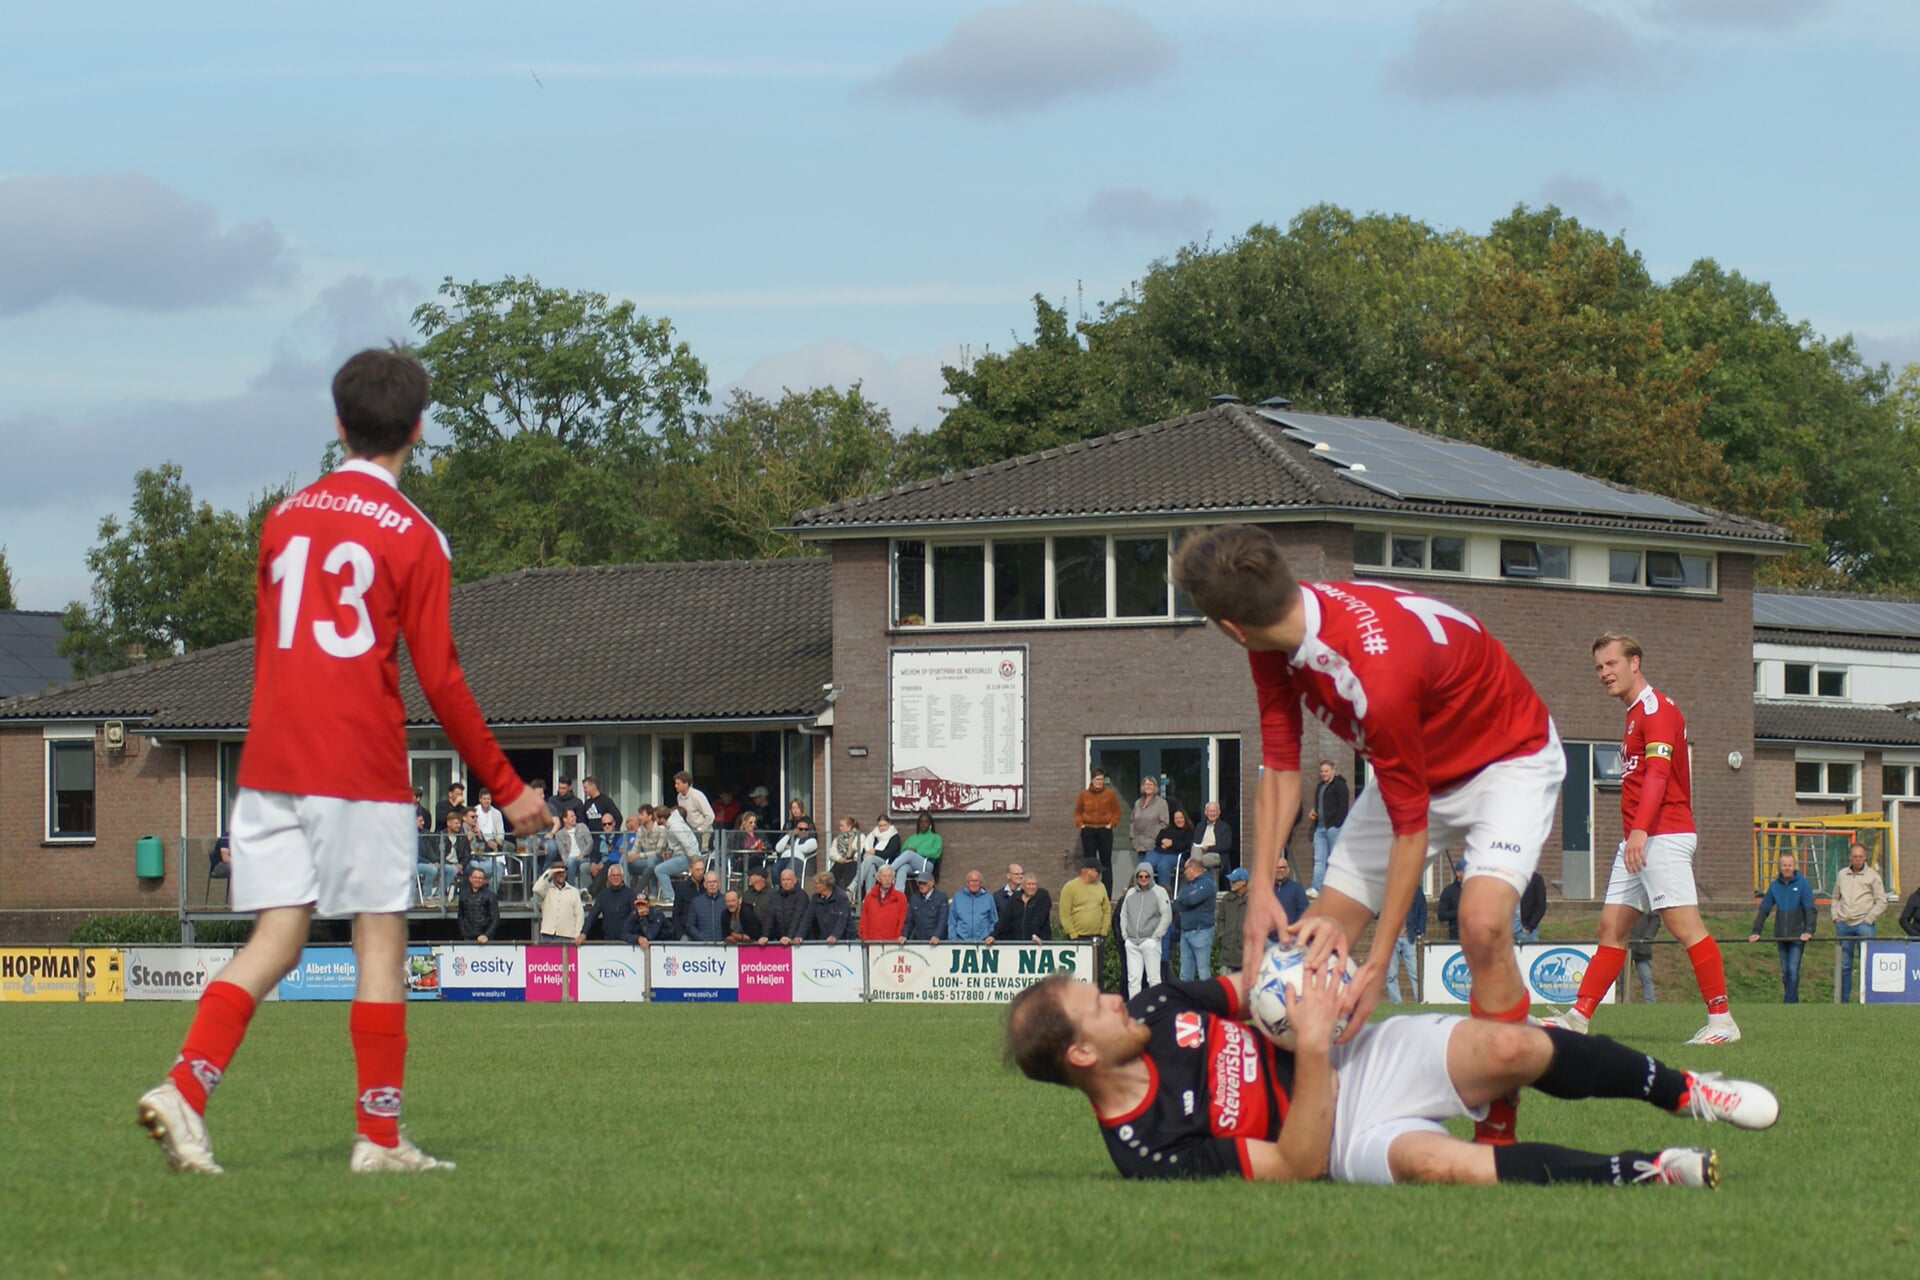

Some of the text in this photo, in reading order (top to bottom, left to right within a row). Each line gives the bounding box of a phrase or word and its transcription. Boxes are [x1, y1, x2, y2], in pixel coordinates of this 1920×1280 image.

[270, 535, 376, 659] 13
[1657, 744, 1669, 756] C
[1489, 841, 1521, 853] JAKO
[470, 956, 514, 977] essity
[682, 956, 726, 977] essity
[949, 949, 1077, 974] JAN NAS
[1879, 958, 1902, 971] bol
[306, 962, 355, 976] Albert Heijn
[528, 962, 576, 974] producert
[597, 968, 625, 978] TENA
[741, 962, 790, 974] produceert
[812, 968, 842, 979] TENA
[891, 965, 912, 974] JAN
[132, 965, 205, 986] Stamer
[533, 974, 543, 984] in
[746, 974, 785, 986] in Heijen
[932, 976, 964, 988] LOON-
[966, 976, 981, 988] EN
[872, 989, 914, 1000] Ottersum
[921, 990, 984, 1001] 0485-517800
[1214, 1053, 1227, 1108] Autoservice
